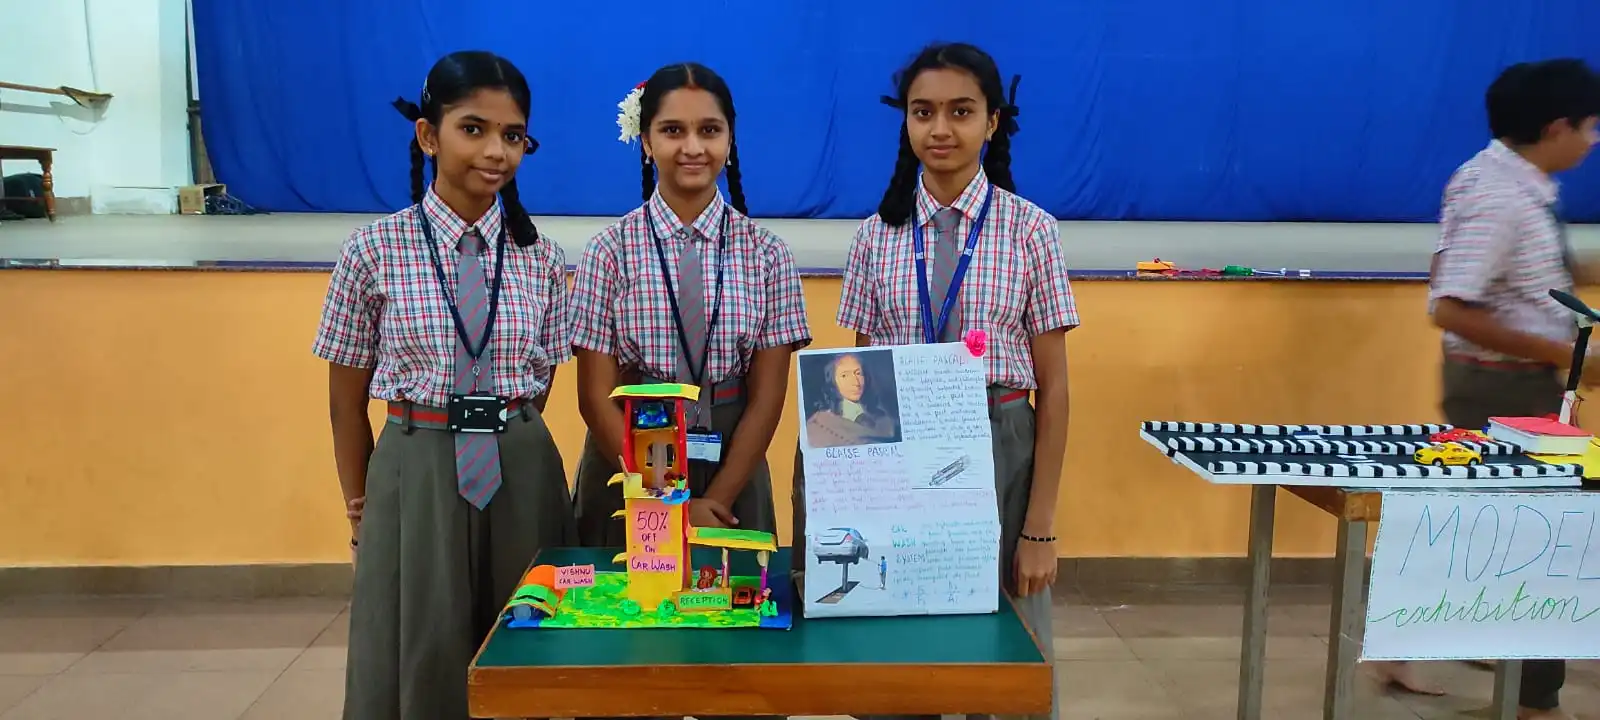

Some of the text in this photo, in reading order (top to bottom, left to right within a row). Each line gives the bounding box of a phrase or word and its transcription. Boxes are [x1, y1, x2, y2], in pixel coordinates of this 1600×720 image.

[825, 447, 860, 459] BLAISE
[636, 511, 669, 531] 50%
[892, 538, 916, 549] WASH
[1399, 504, 1600, 582] MODEL
[896, 552, 926, 565] SYSTEM
[560, 568, 591, 576] VISHNU
[573, 577, 593, 585] WASH
[680, 596, 728, 606] RECEPTION
[1367, 581, 1600, 627] exhibition
